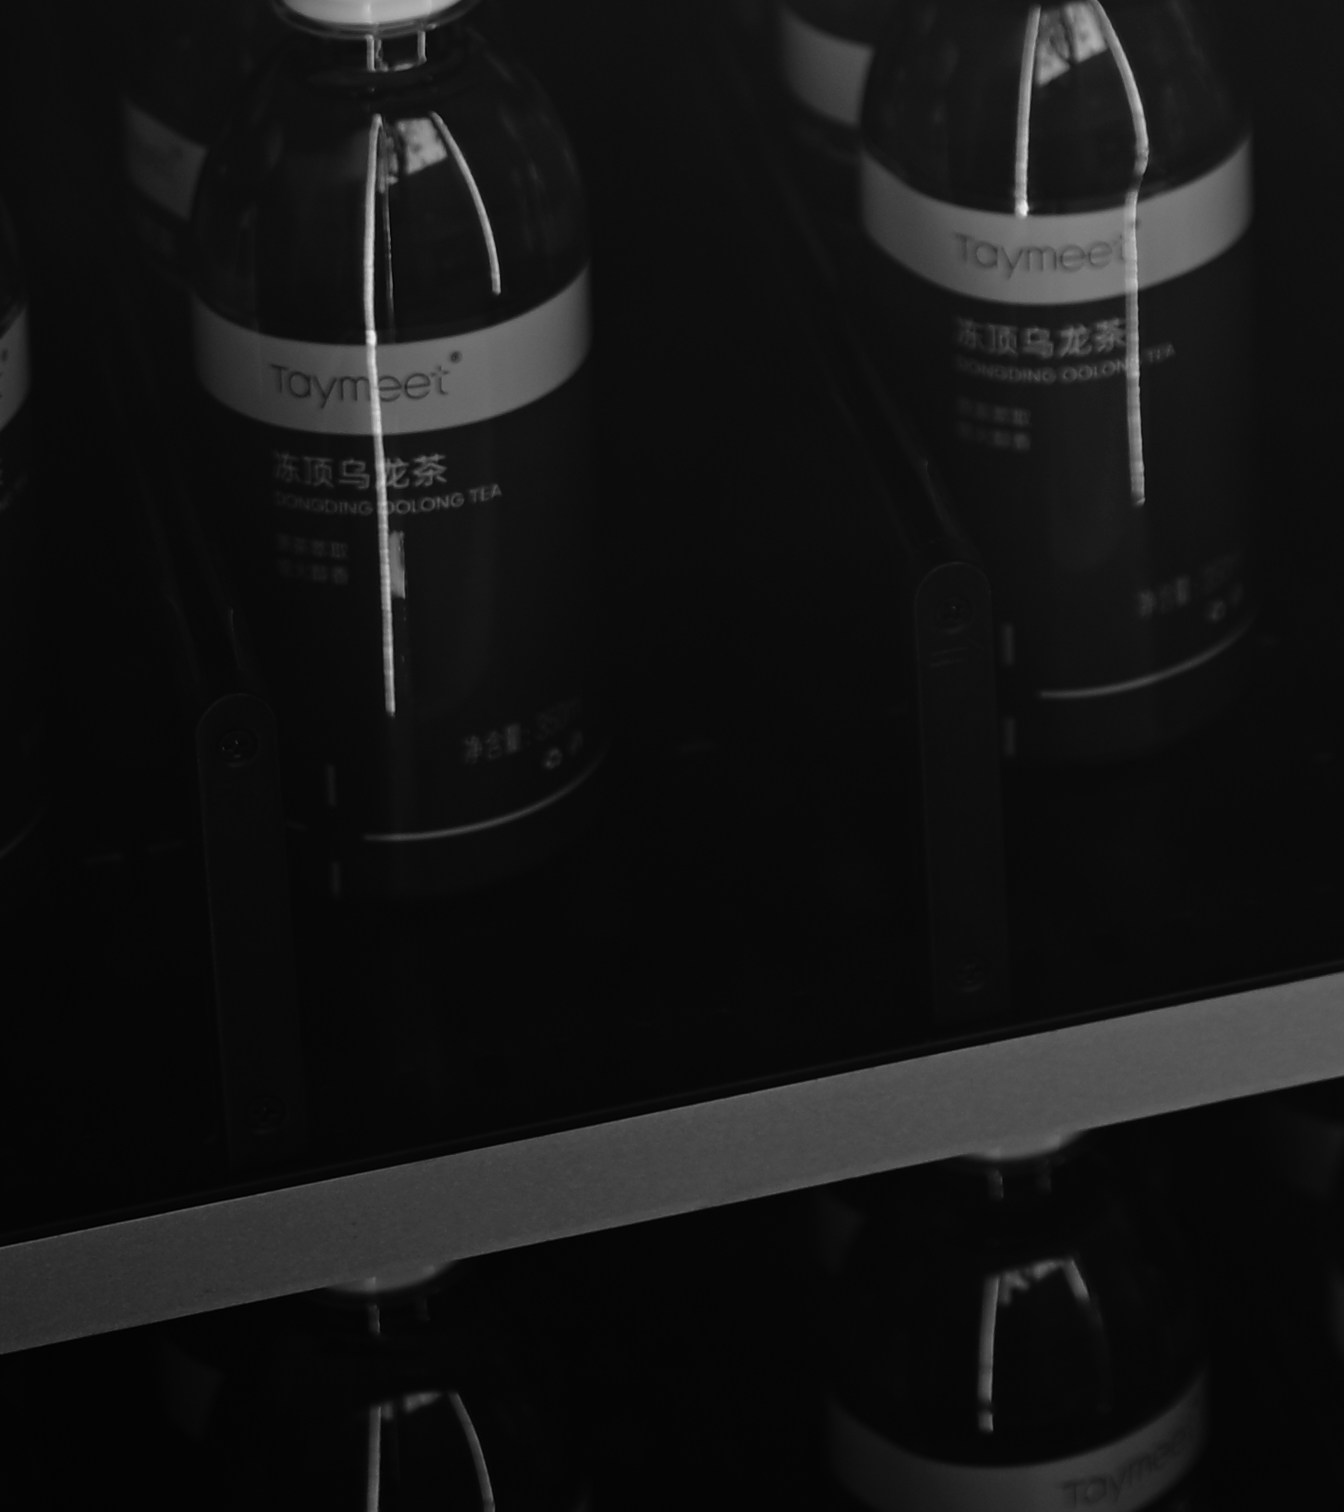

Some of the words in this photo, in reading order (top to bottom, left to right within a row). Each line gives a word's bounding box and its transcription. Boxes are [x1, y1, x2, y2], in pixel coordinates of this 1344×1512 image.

[273, 449, 448, 490] 冻顶乌龙茶
[469, 482, 503, 505] TEA
